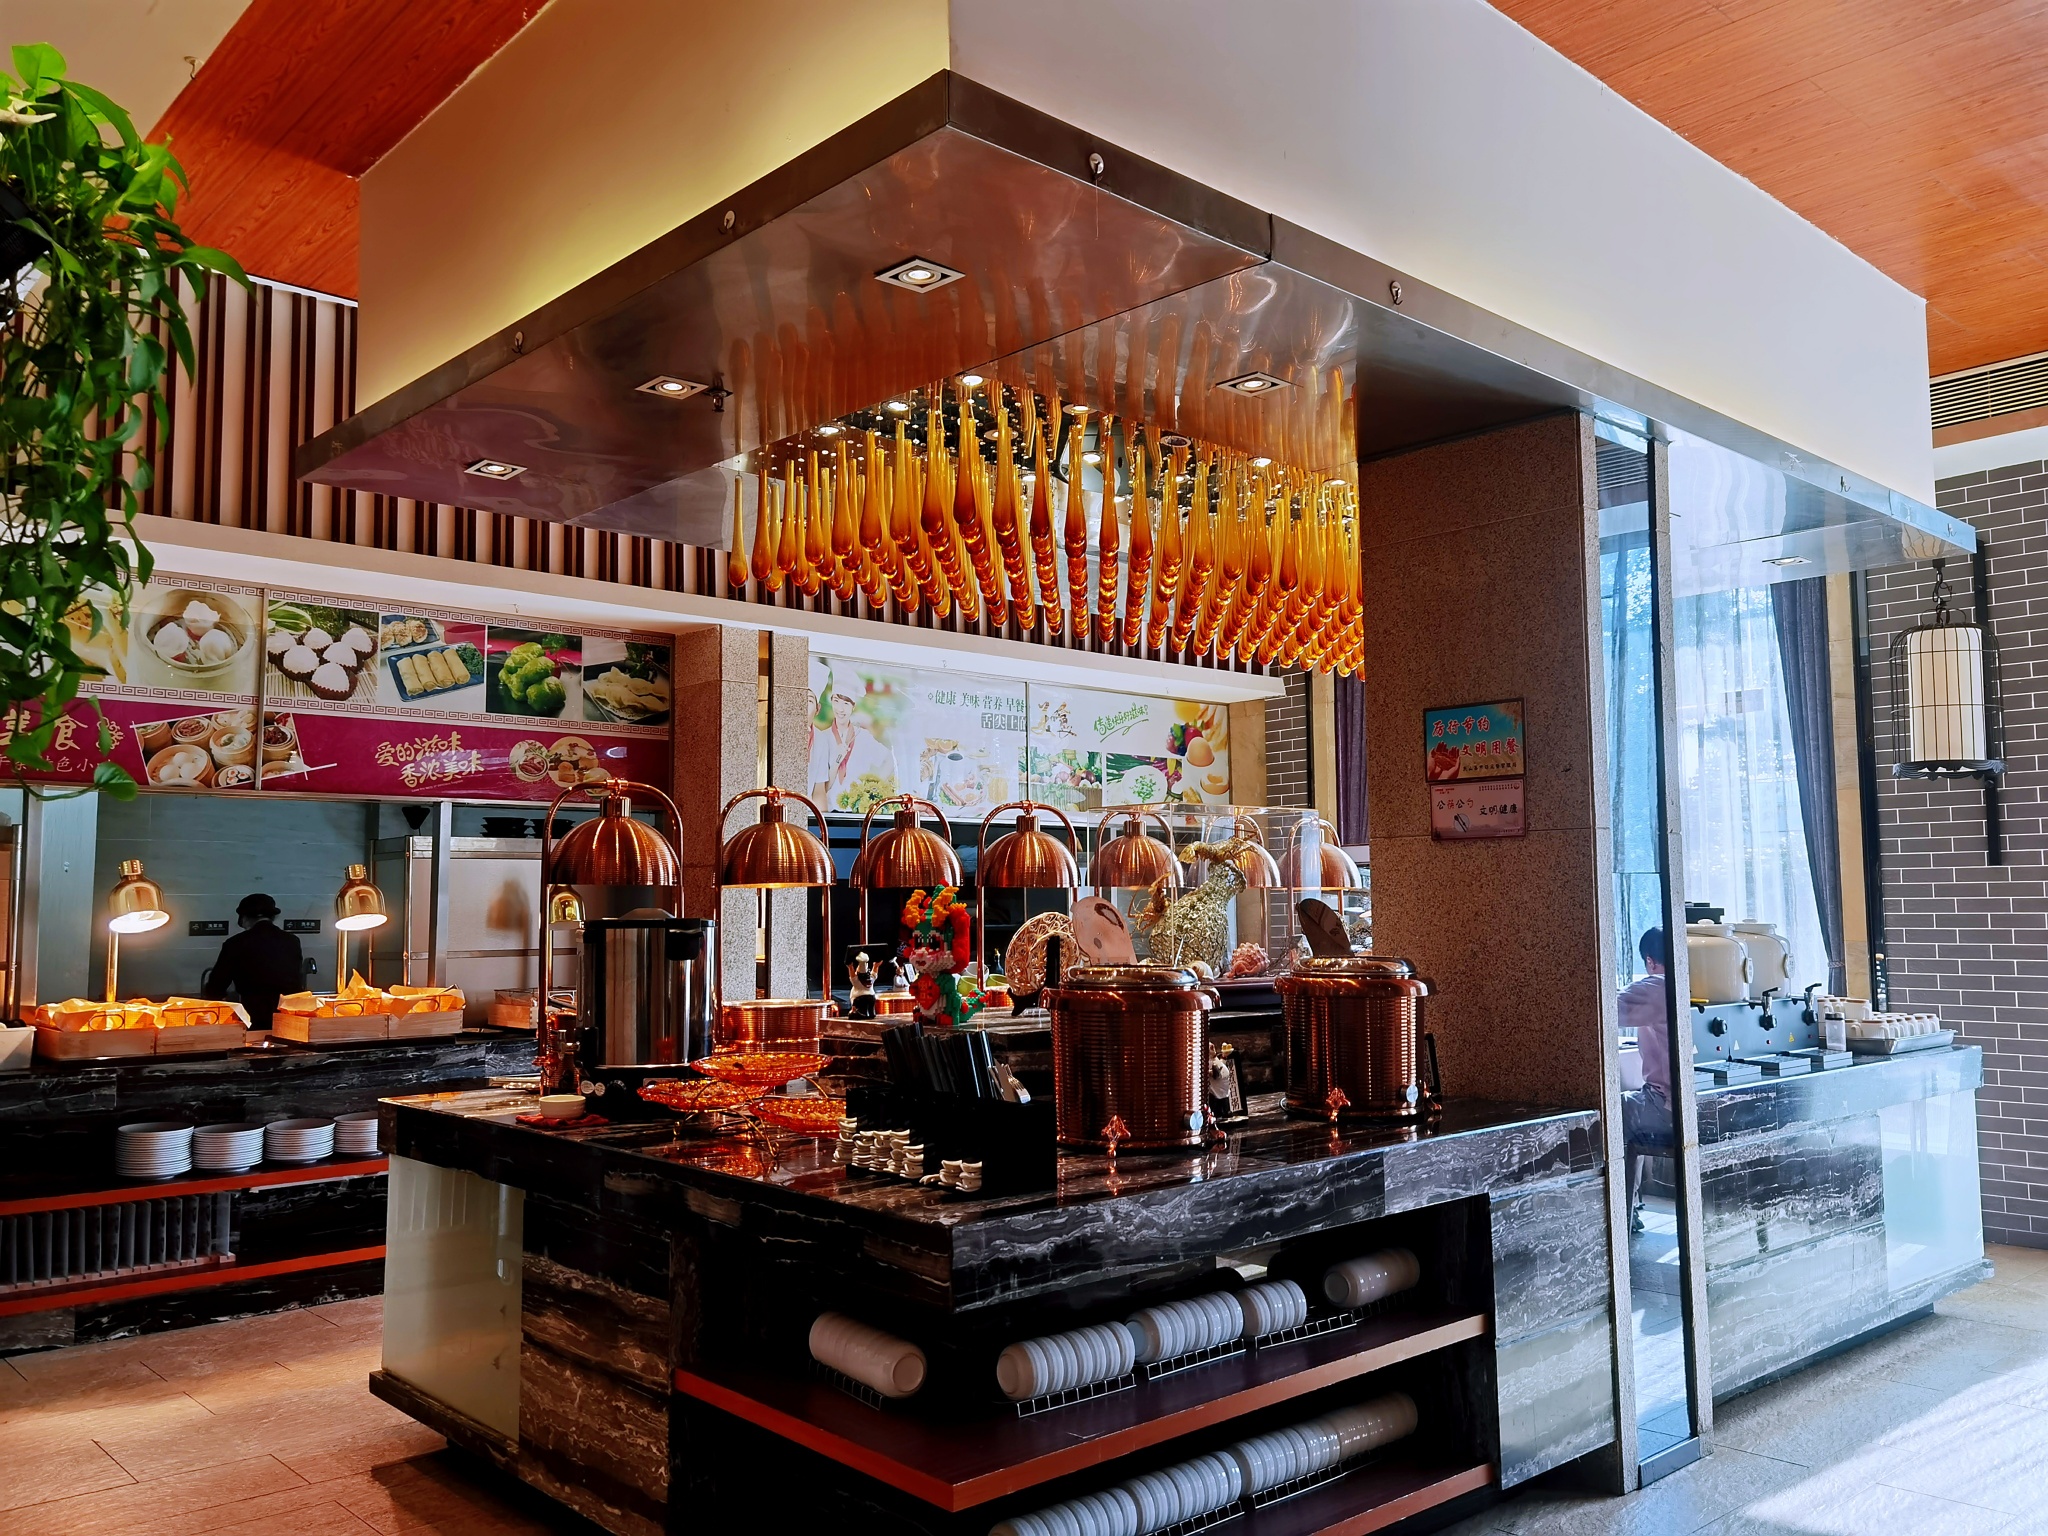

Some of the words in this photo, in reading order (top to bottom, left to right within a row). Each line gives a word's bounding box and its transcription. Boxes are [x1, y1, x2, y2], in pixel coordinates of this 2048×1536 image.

[935, 689, 956, 705] 健康
[960, 692, 980, 708] 美味
[983, 695, 1003, 710] 营养
[1006, 697, 1025, 713] 早餐
[1432, 715, 1490, 737] 厉行节约
[375, 731, 464, 766] 爱的滋味
[1461, 737, 1519, 758] 文明用餐
[399, 750, 485, 787] 香浓美味
[1437, 798, 1474, 810] 公筷公勺
[1480, 803, 1518, 815] 文明健康
